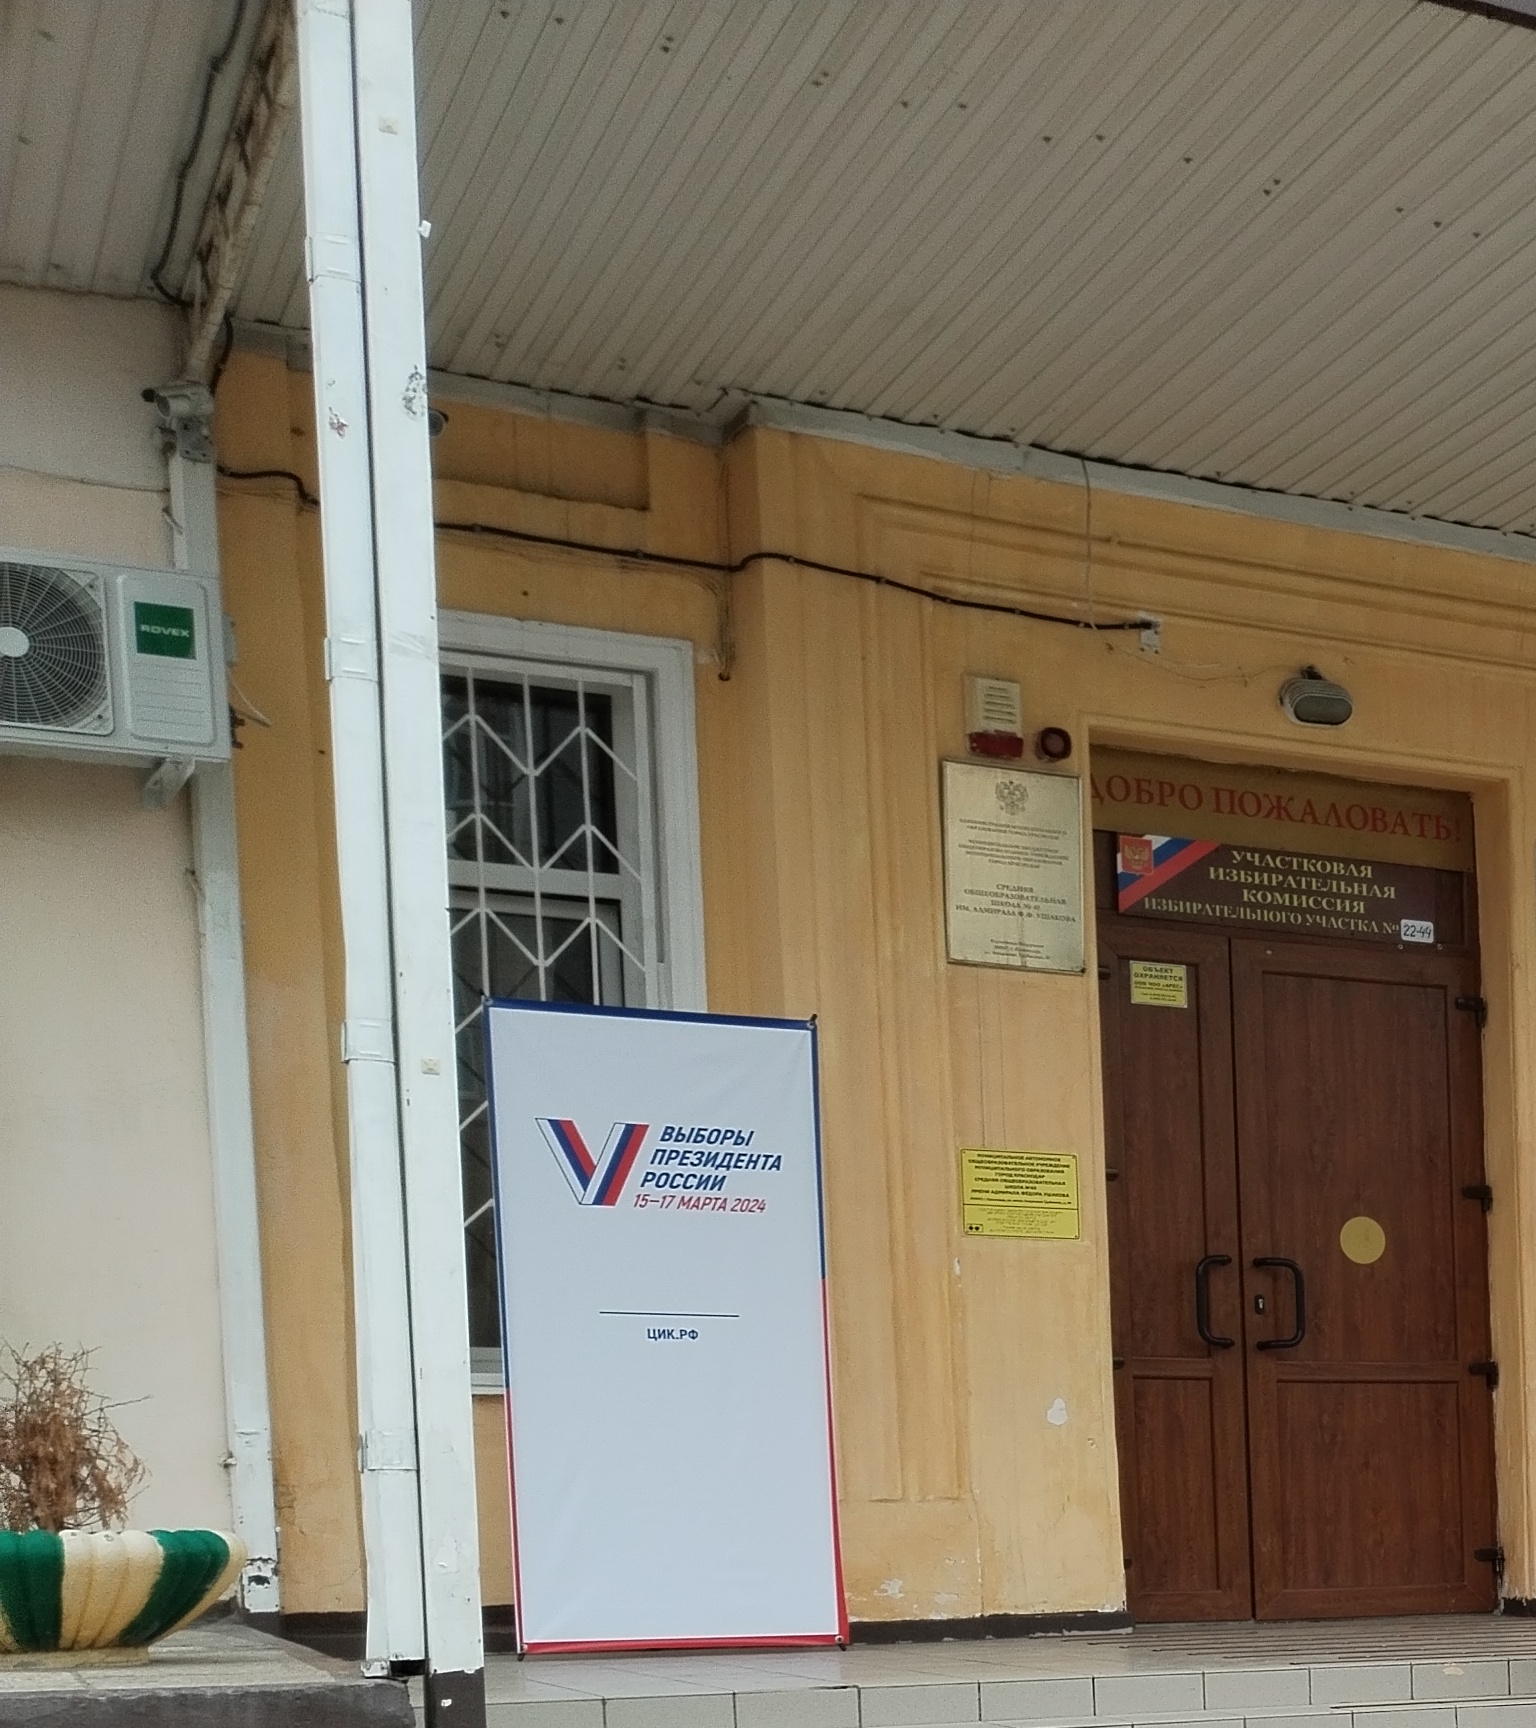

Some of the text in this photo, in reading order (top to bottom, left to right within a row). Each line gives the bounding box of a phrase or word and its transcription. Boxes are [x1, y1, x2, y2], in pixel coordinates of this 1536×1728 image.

[141, 624, 190, 638] ROVEX
[1211, 787, 1461, 842] ПОЖАЛОВАТЬ!
[1231, 850, 1373, 878] УЧАСТКОВАЯ
[1208, 866, 1396, 898] ИЗБИРАТЕЛЬНАЯ
[1242, 888, 1366, 914] КОМИССИЯ
[1144, 897, 1302, 925] ИЗБИРАТЕЛЬНОГО
[1305, 913, 1379, 933] УЧАСТКА
[1403, 924, 1432, 939] 22-44
[659, 1125, 755, 1147] ВЫБОРЫ
[650, 1148, 783, 1172] ПРЕЗИДЕНТА
[640, 1171, 727, 1192] РОССИИ
[677, 1195, 729, 1212] МАРТА
[730, 1198, 767, 1213] 2024
[647, 1328, 699, 1341] ЦИК.РФ
